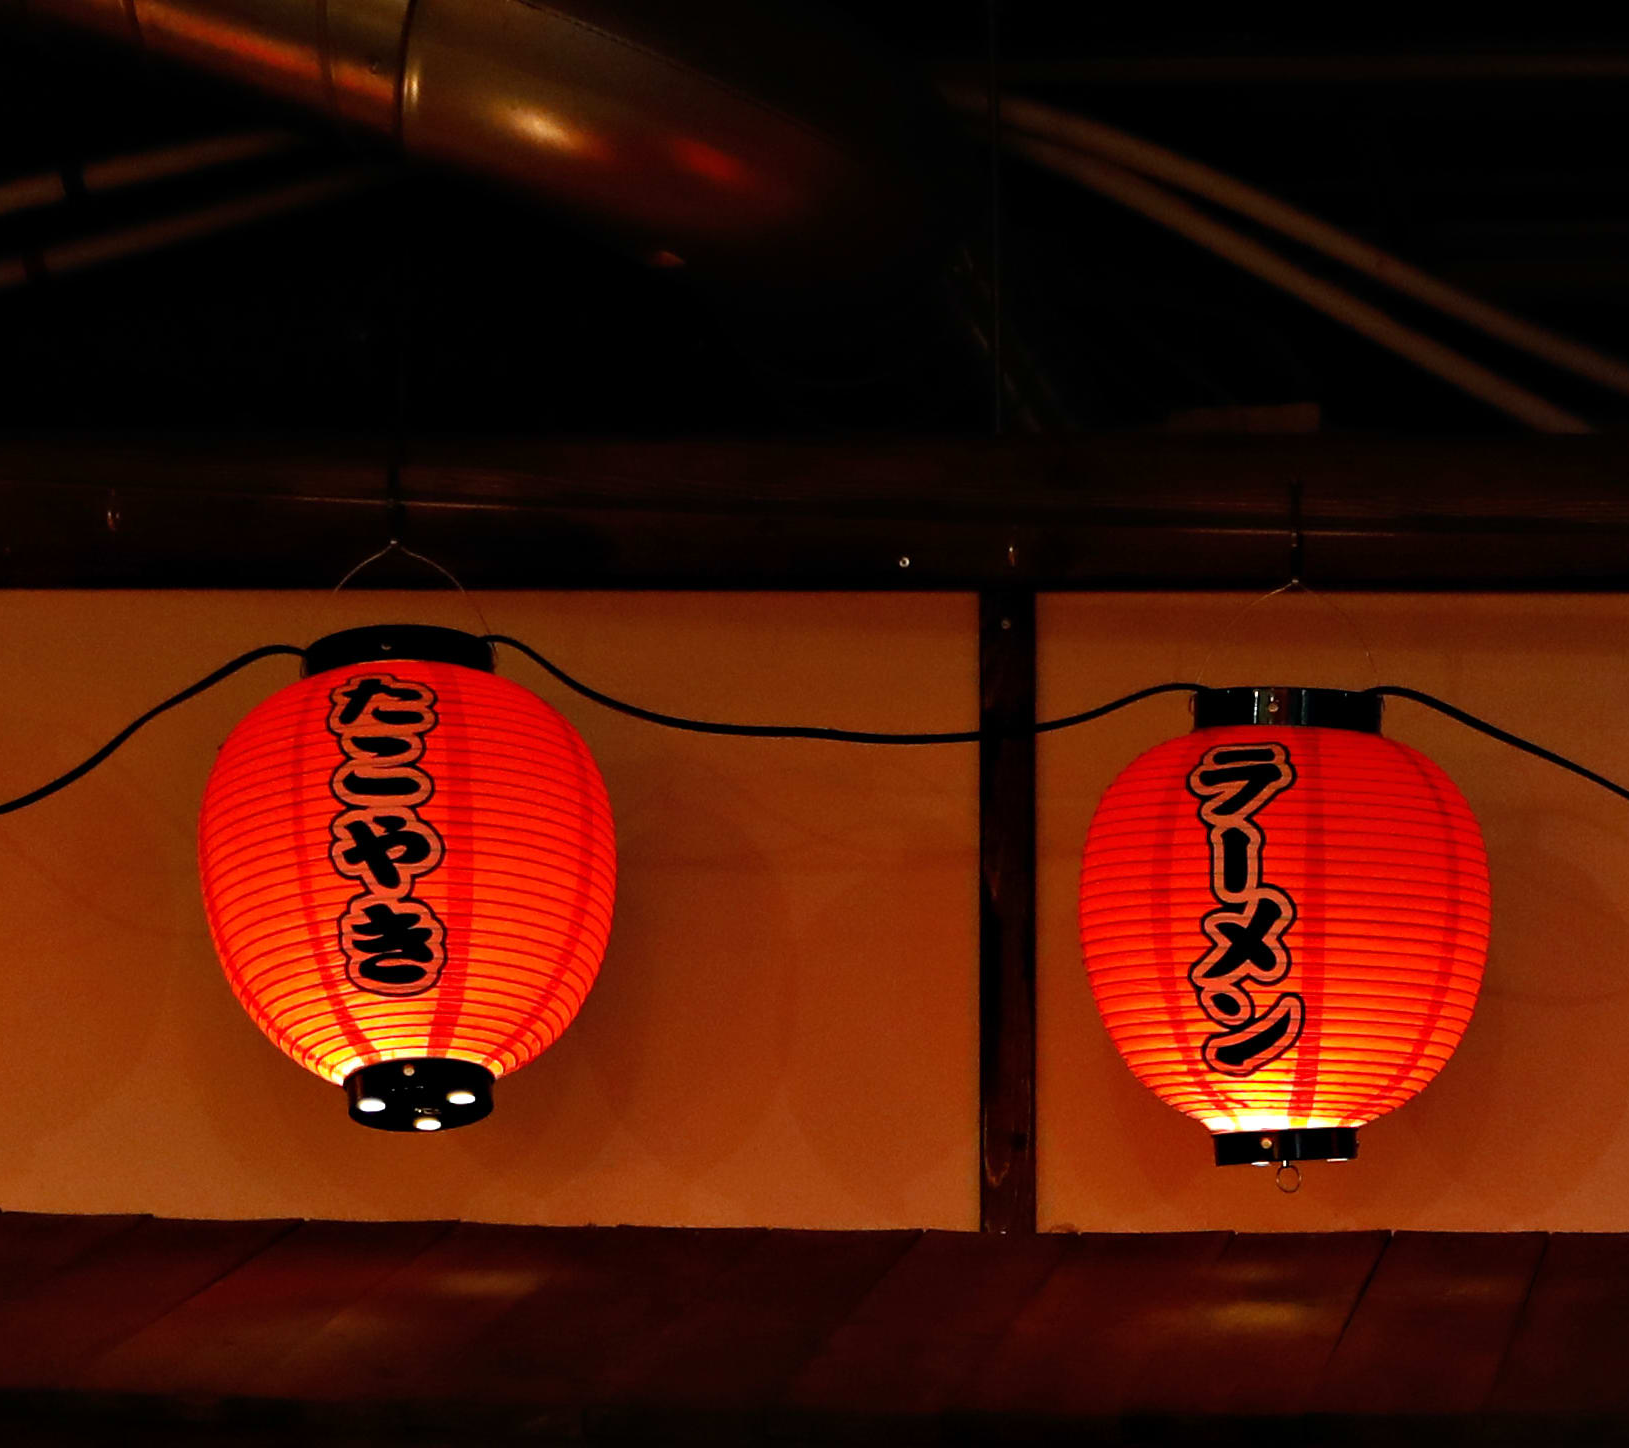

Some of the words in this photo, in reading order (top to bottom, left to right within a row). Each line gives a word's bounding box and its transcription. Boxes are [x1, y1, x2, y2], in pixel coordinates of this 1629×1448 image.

[326, 672, 448, 998] たこやき
[1186, 741, 1306, 1078] ラーメン
